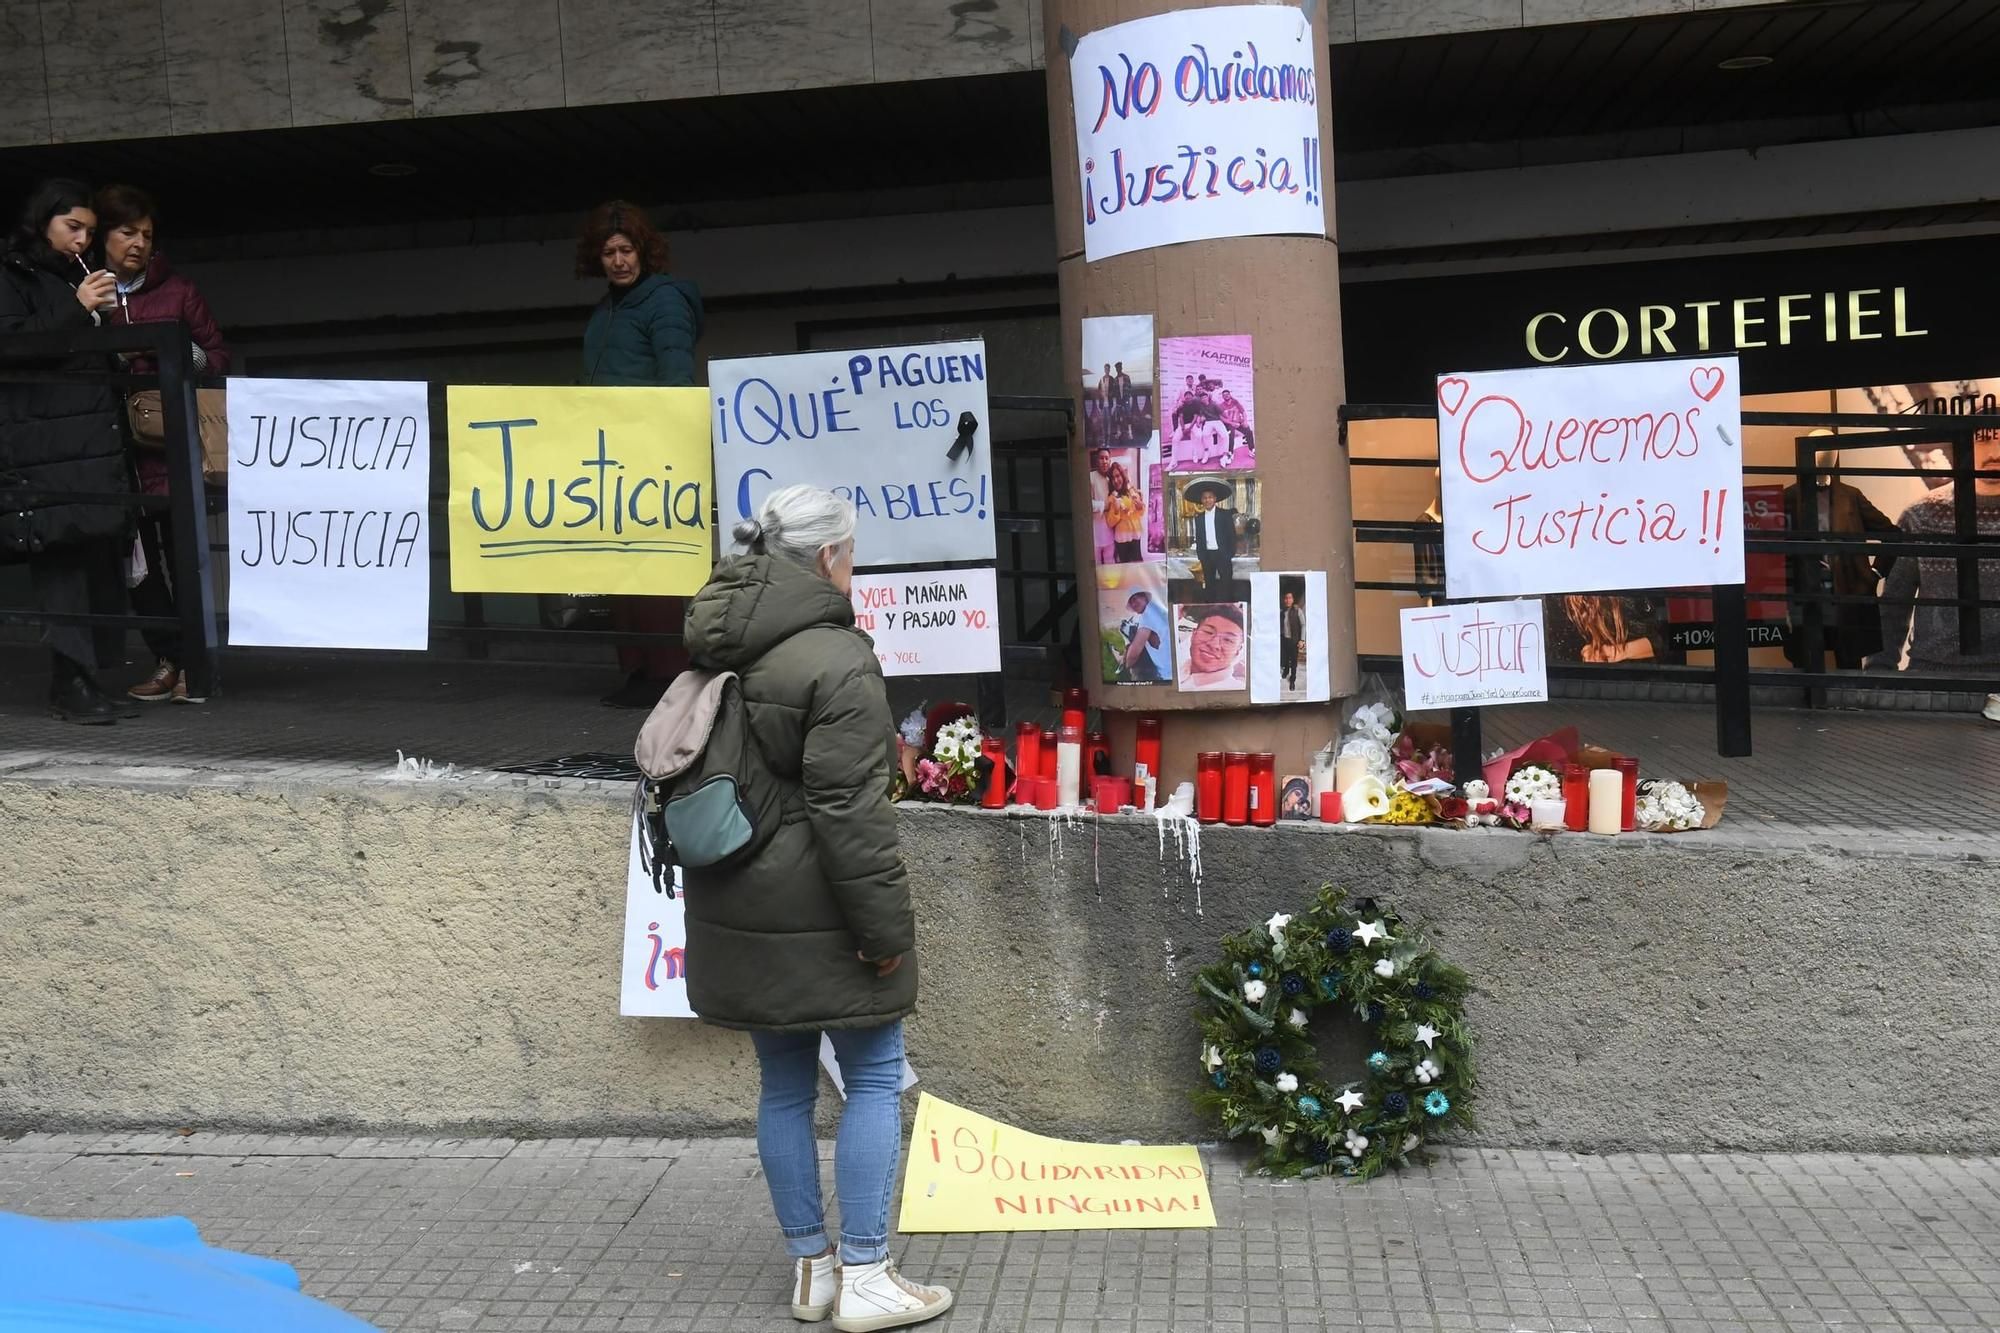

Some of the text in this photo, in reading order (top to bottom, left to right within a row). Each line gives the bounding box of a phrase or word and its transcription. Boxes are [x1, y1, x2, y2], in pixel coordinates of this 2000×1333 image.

[1174, 41, 1316, 106] Olvidamos
[1526, 287, 1928, 362] CORTEFIEL
[849, 352, 984, 395] PAGUEN
[1201, 350, 1251, 364] KARTING
[894, 398, 951, 430] LOS
[1459, 394, 1702, 483] Queremos
[237, 415, 417, 470] JUSTICIA
[468, 418, 705, 532] Justicia
[240, 510, 421, 567] JUSTICIA
[859, 581, 968, 609] YOEL MAÑANA
[885, 612, 896, 630] Y
[903, 609, 956, 630] PASADO
[1410, 607, 1542, 682] JUSTICIA
[1747, 626, 1783, 642] TRA
